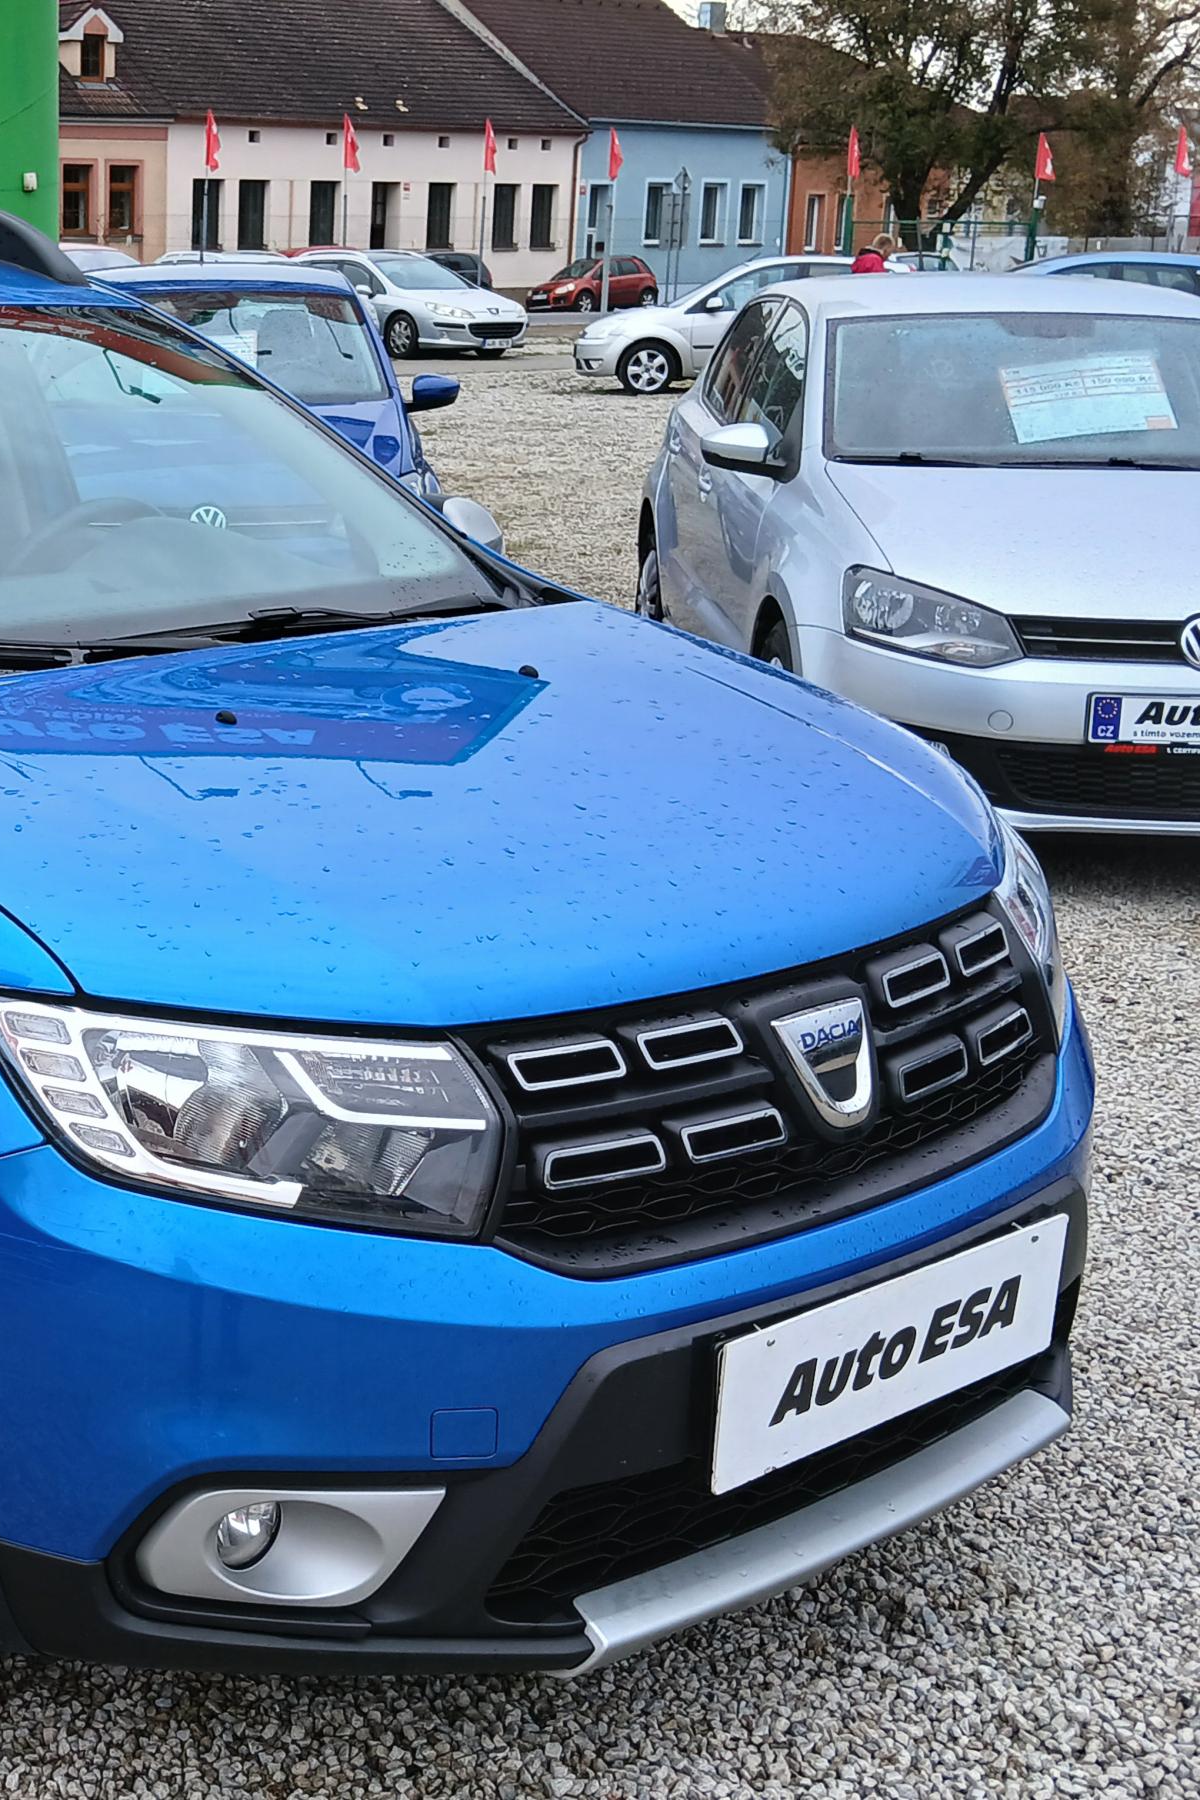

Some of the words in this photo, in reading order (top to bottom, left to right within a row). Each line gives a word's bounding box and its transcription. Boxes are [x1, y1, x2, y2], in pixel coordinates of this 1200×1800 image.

[1097, 725, 1115, 737] CZ
[800, 1019, 861, 1050] DACIA
[768, 1325, 917, 1428] Auto
[917, 1274, 1022, 1365] ESA
